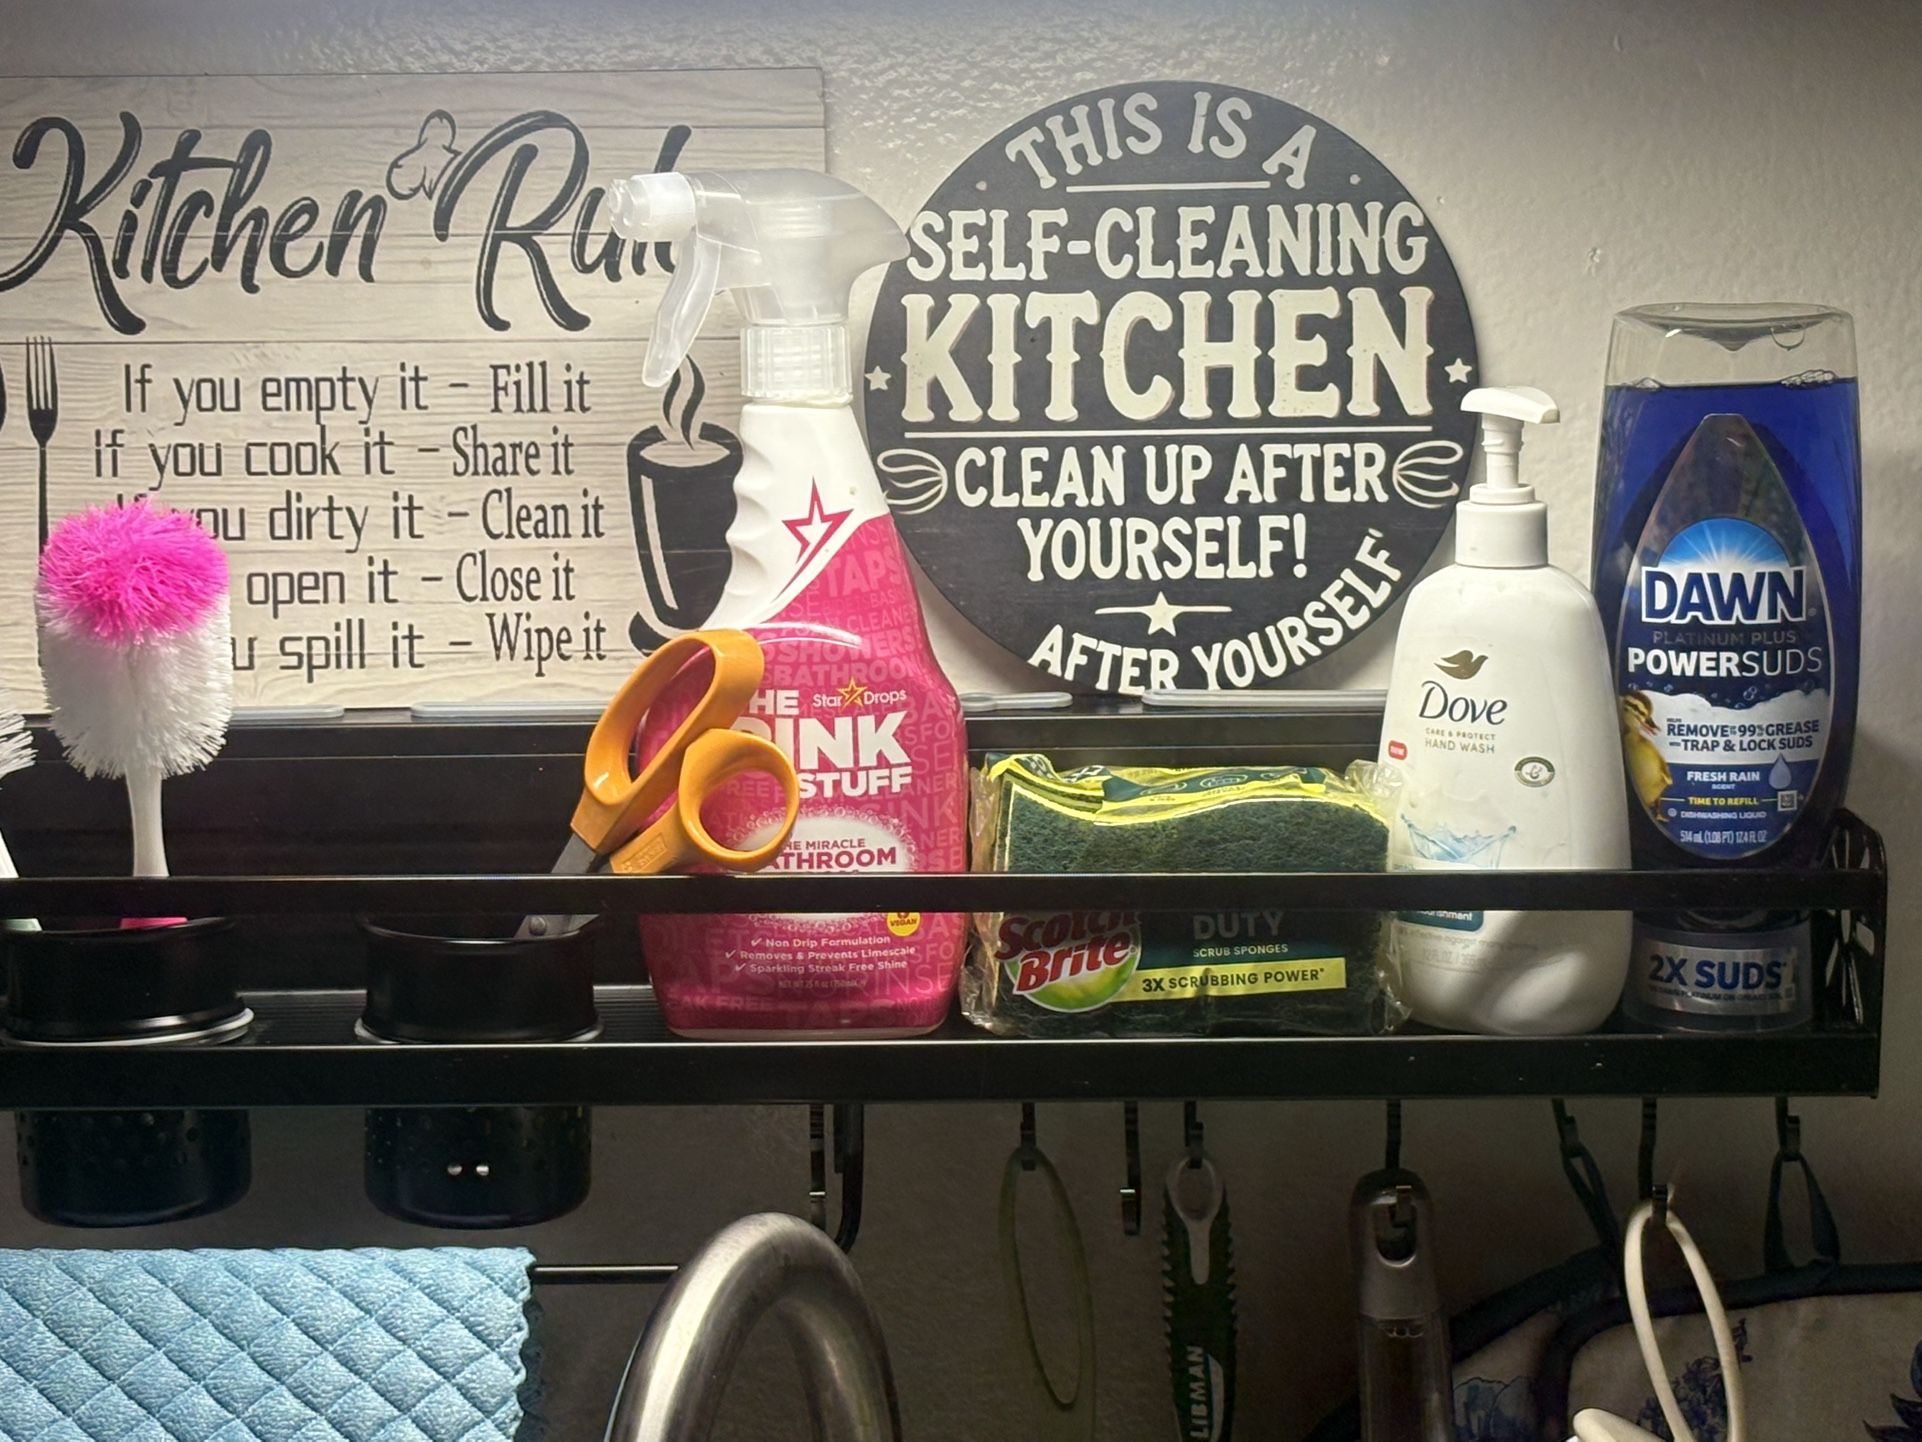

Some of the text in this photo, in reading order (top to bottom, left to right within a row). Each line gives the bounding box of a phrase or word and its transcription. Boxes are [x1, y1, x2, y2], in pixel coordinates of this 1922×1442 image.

[1005, 90, 1317, 190] THIS IS A
[0, 108, 692, 336] Kitchen Rul
[906, 201, 1429, 282] SELF-CLEANING
[901, 286, 1434, 423] KITCHEN
[125, 364, 152, 414] If
[173, 376, 241, 425] you
[261, 366, 379, 426] empty
[400, 362, 429, 412] it
[489, 363, 549, 414] Fill
[563, 364, 591, 413] it
[148, 442, 222, 491] you
[245, 424, 341, 477] cook
[364, 419, 395, 475] it
[452, 425, 540, 478] Share
[551, 425, 575, 476] it
[954, 442, 1389, 509] CLEAN UP AFTER
[268, 490, 368, 552] dirty
[392, 492, 425, 541] it
[481, 488, 570, 540] Clean
[580, 488, 605, 539] it
[1017, 513, 1307, 581] YOURSELF!
[247, 570, 346, 618] open
[367, 556, 399, 603] it
[455, 553, 541, 602] Close
[551, 550, 576, 601] it
[1642, 567, 1806, 624] DAWN
[279, 618, 365, 682] spill
[391, 622, 425, 668] it
[486, 612, 572, 677] Wipe
[580, 610, 608, 661] it
[1653, 630, 1797, 646] PLATINUM PLUS
[1026, 624, 1179, 697] AFTER
[1627, 646, 1823, 677] POWERSUDS
[750, 689, 800, 715] HE
[812, 688, 907, 708] Star Drops
[1418, 680, 1508, 725] Dove
[1425, 727, 1445, 737] CARE
[1456, 731, 1496, 741] PROTECT
[1667, 723, 1730, 737] REMOVE
[1765, 720, 1819, 736] GREASE
[1682, 739, 1720, 751] TRAP
[1723, 739, 1736, 752] &
[1739, 739, 1778, 751] LOCK
[1779, 735, 1813, 749] SUDS
[1424, 737, 1496, 754] HAND WASH
[798, 766, 913, 799] STUFF
[1687, 771, 1760, 782] FRESH RAIN
[1688, 796, 1759, 805] TIME TO REFILL
[785, 838, 866, 851] HE MIRACLE
[890, 919, 917, 927] VEGAN
[1193, 911, 1283, 940] DUTY
[740, 945, 916, 961] Removes & Prevents Limescale
[765, 935, 891, 949] Non Drip Formulation
[1193, 943, 1288, 958] SCRUB SPONGES
[749, 959, 907, 975] Sparkling Streak Free Shine
[1016, 931, 1131, 992] Brite
[1648, 954, 1688, 986] 2X
[1142, 977, 1166, 993] 3X
[1169, 972, 1258, 990] SCRUBBING
[1186, 1345, 1209, 1438] LIBMAN
